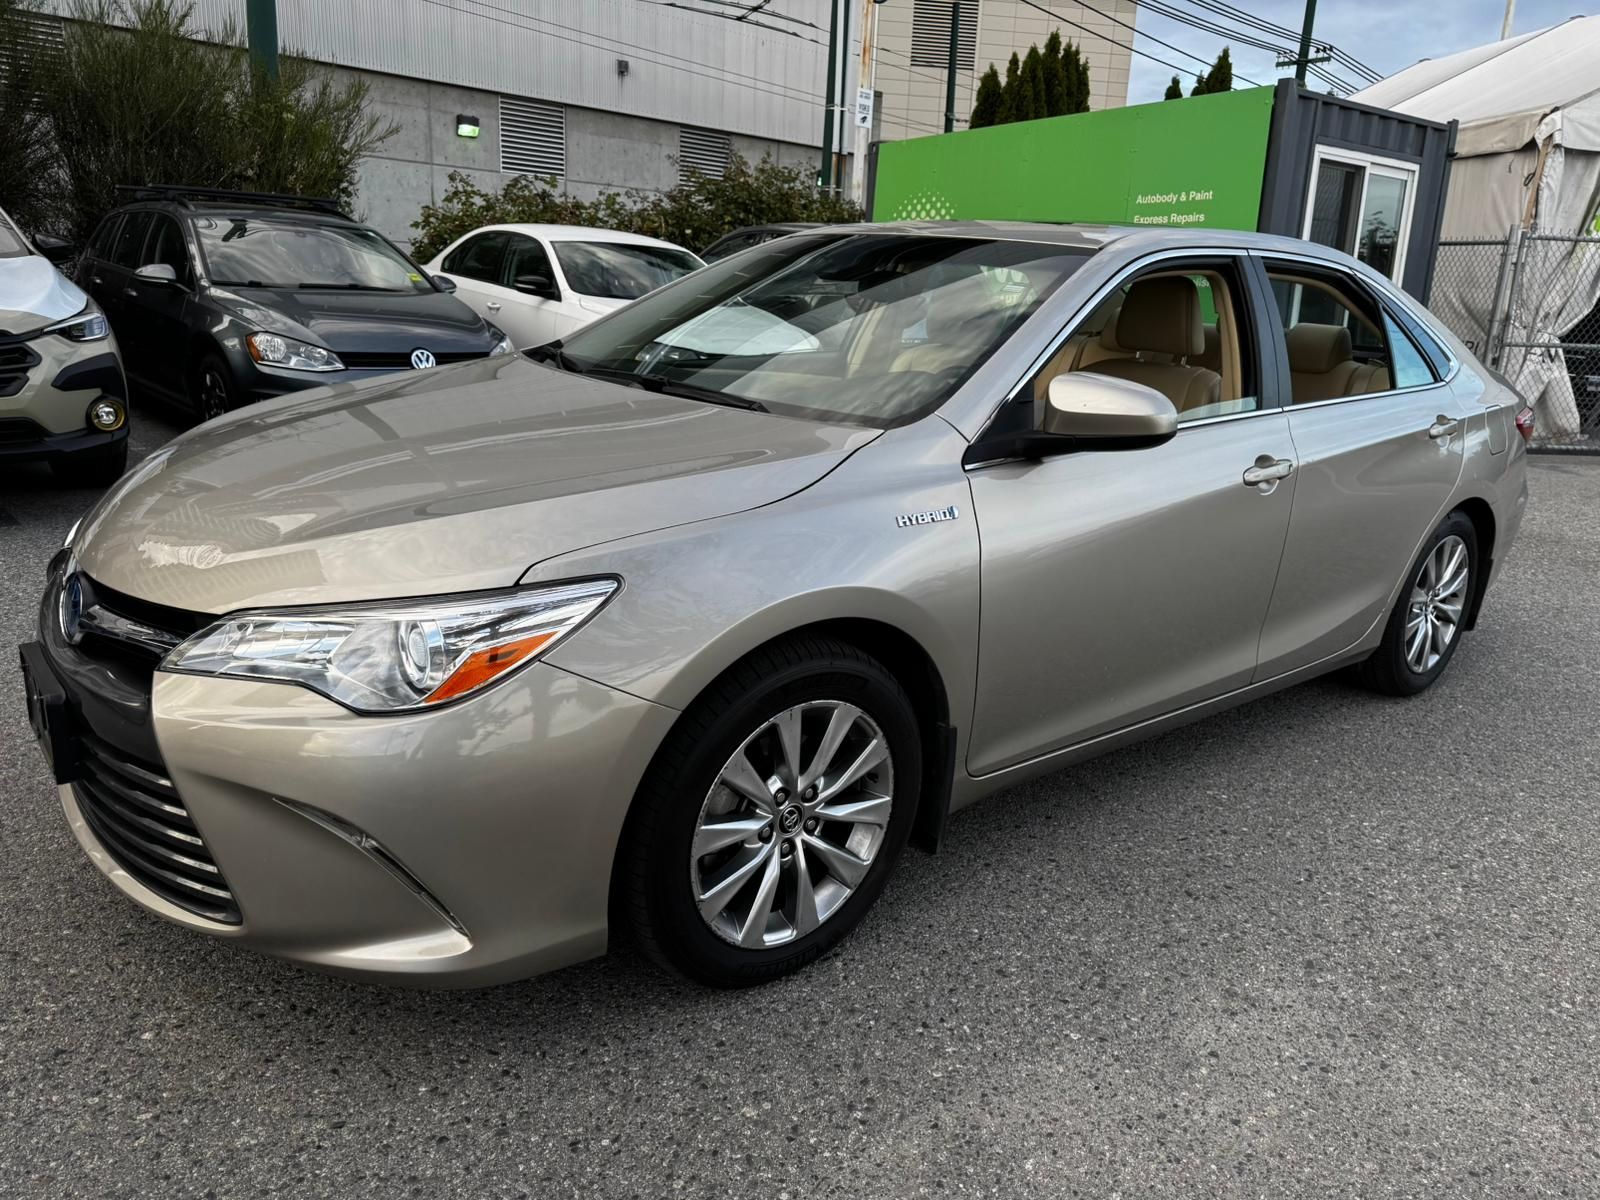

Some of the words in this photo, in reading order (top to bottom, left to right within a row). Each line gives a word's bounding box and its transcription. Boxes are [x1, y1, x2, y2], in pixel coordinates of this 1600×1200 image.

[1136, 193, 1178, 204] Autobody
[1180, 191, 1187, 202] &
[1189, 189, 1213, 201] Paint
[1134, 215, 1168, 224] Express
[1170, 212, 1205, 225] Repairs
[896, 509, 951, 527] HYBRID
